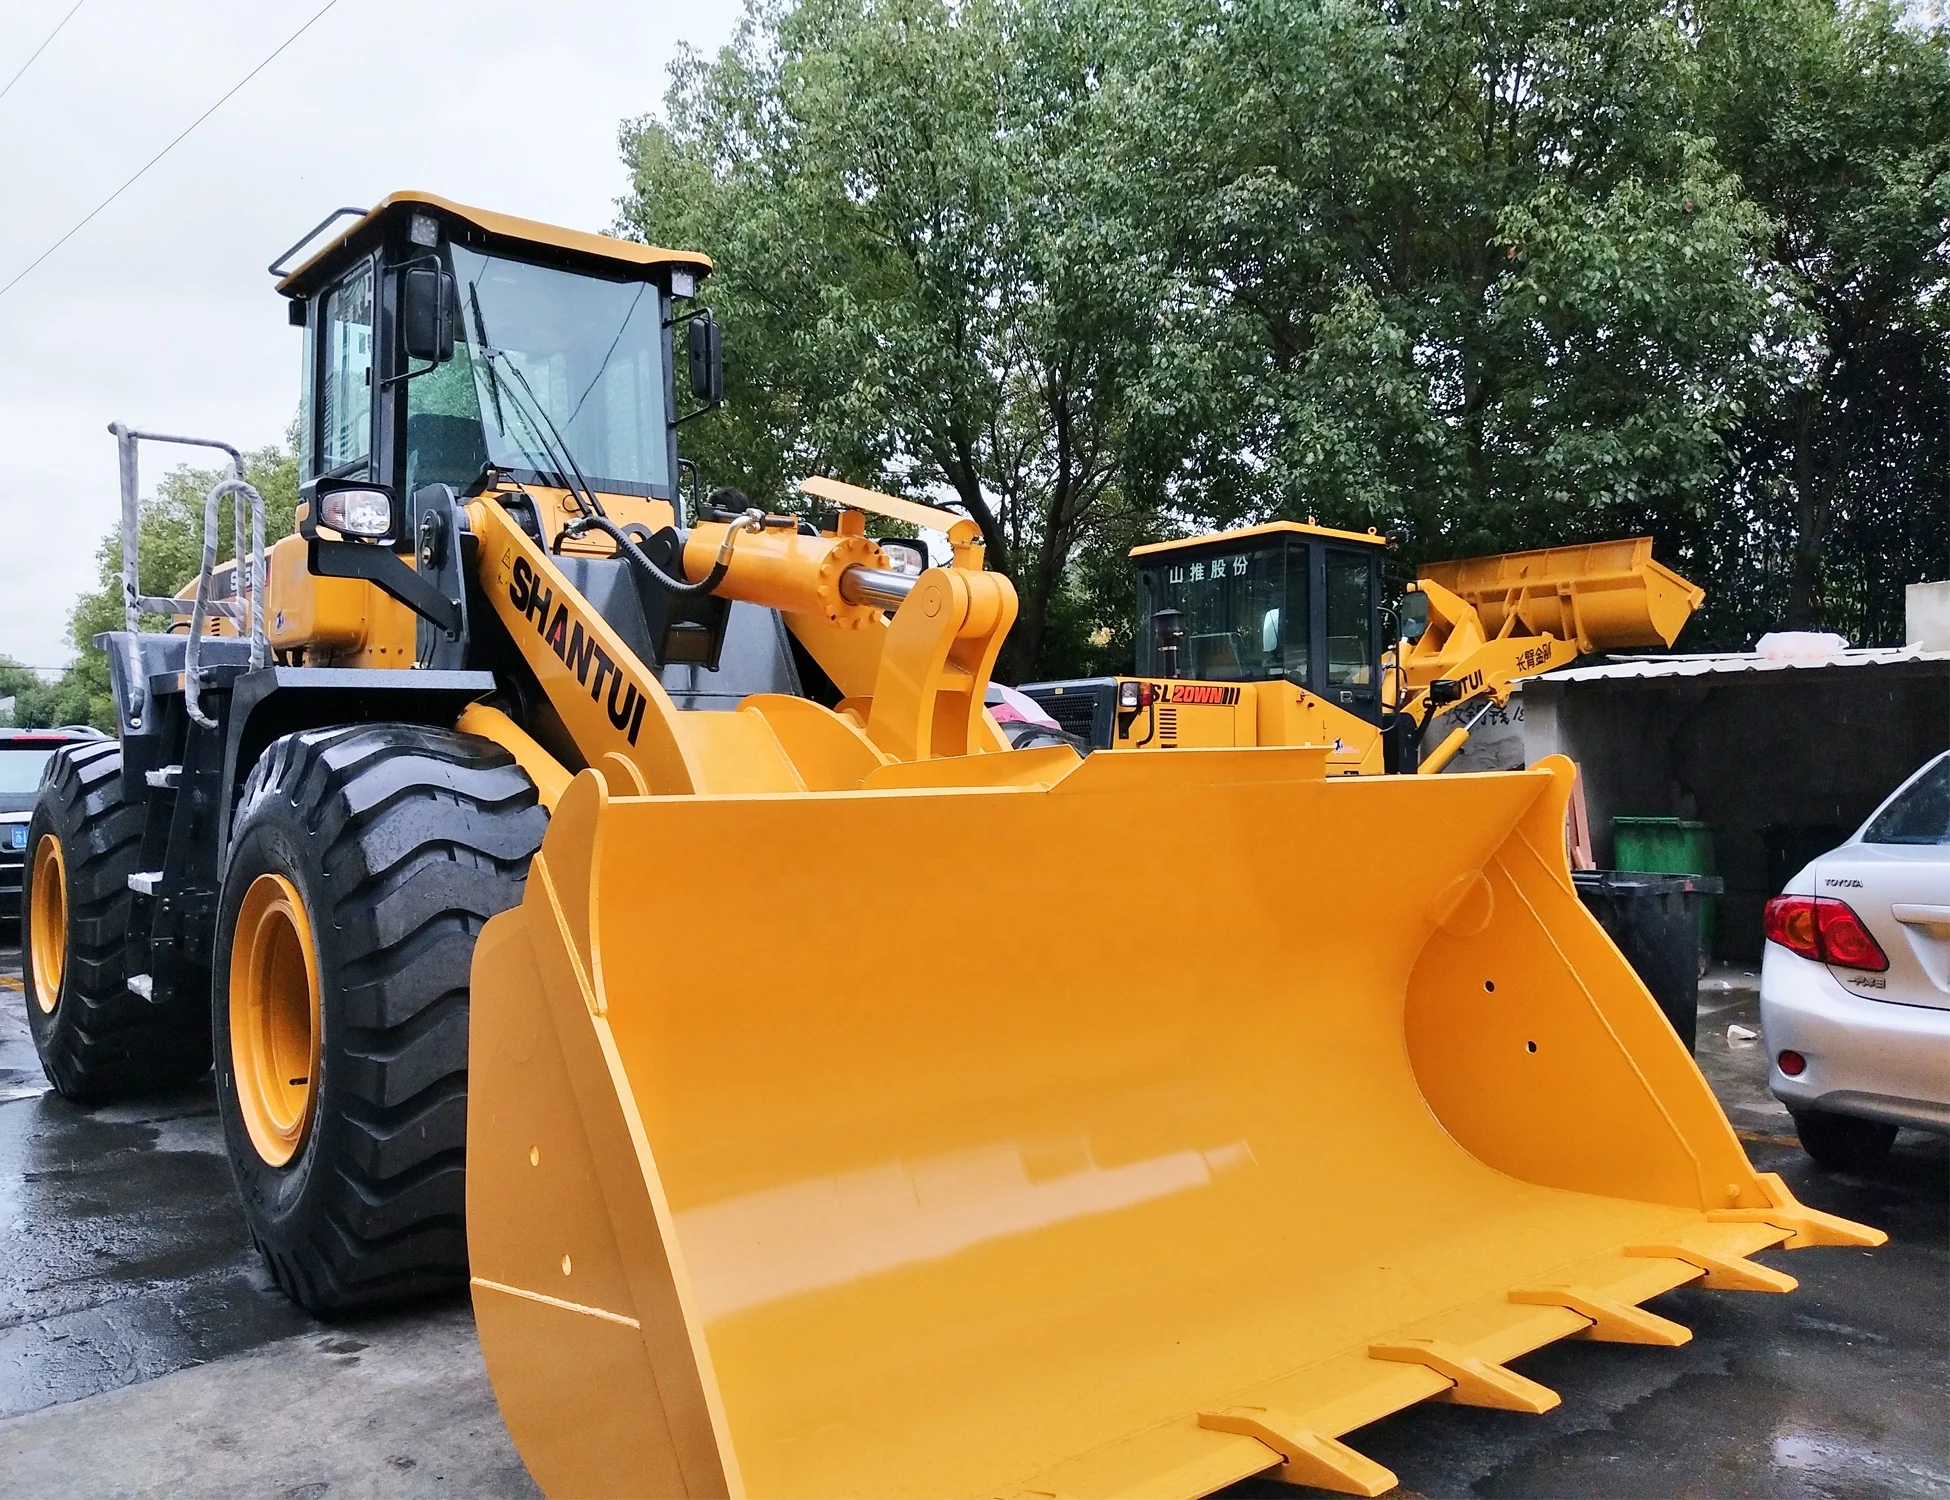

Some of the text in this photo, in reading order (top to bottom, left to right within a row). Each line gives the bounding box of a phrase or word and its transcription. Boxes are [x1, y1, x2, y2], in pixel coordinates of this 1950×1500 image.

[1169, 556, 1249, 584] 山推股份
[509, 556, 647, 748] SHANTUI
[1515, 641, 1552, 672] 长臂金刚
[1825, 879, 1863, 888] TOYOTA
